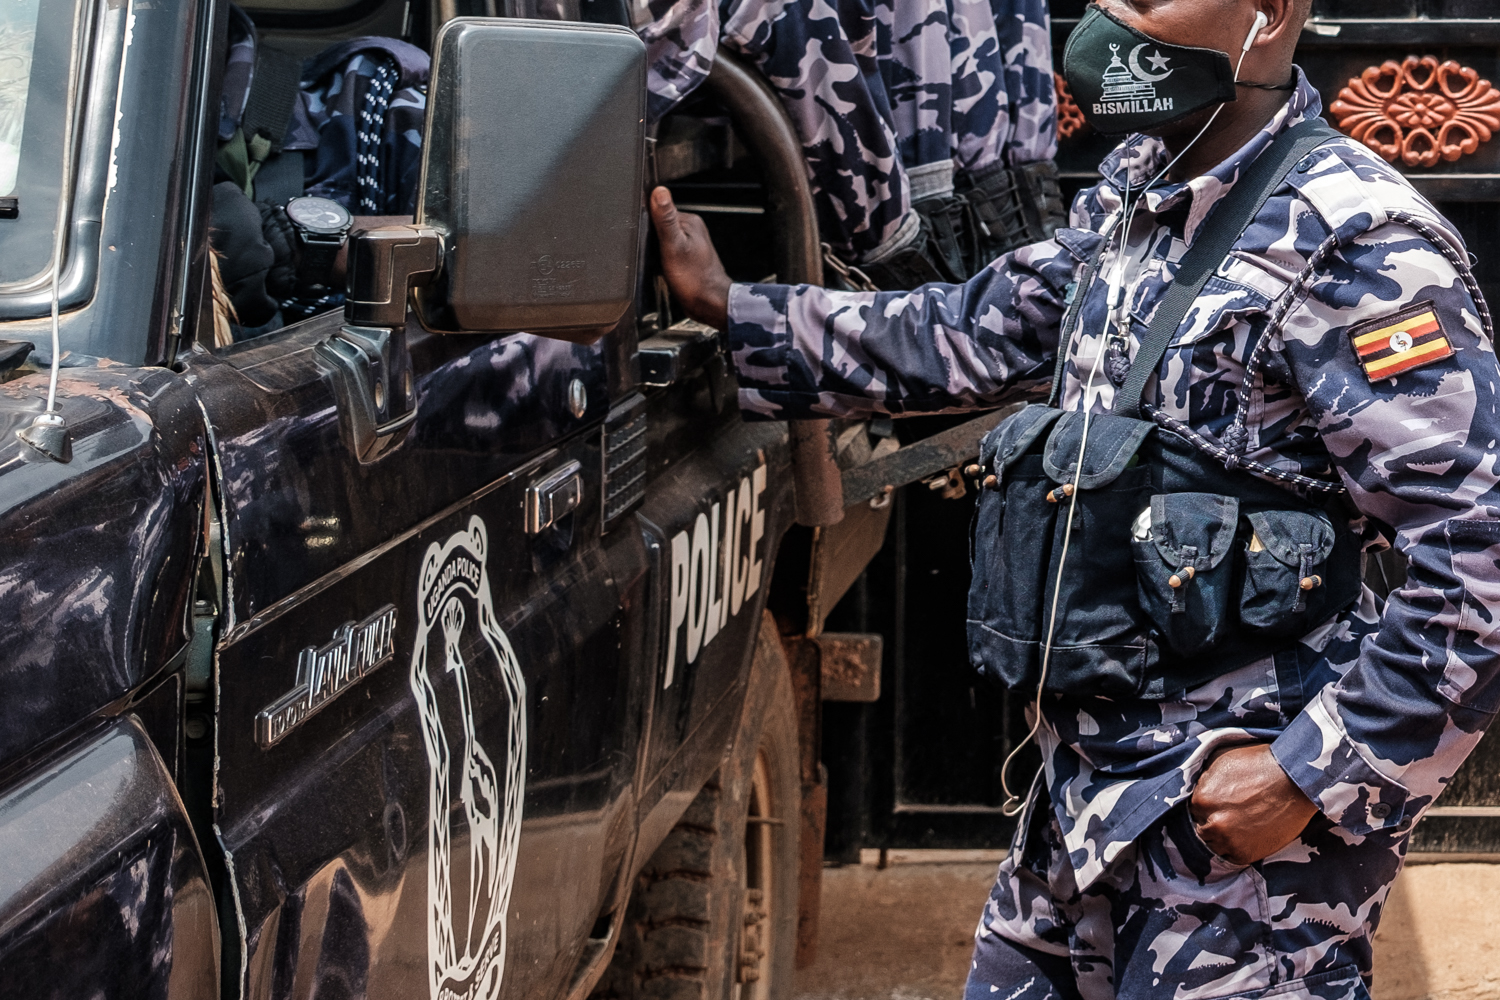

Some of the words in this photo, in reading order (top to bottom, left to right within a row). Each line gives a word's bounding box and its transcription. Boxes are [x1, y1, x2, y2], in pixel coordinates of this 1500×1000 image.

[1092, 97, 1174, 115] BISMILLAH
[428, 560, 457, 619] UGANDA
[457, 557, 480, 589] POLICE
[664, 464, 767, 690] POLICE
[272, 700, 309, 738] TOYOTA
[475, 931, 500, 990] SERVE
